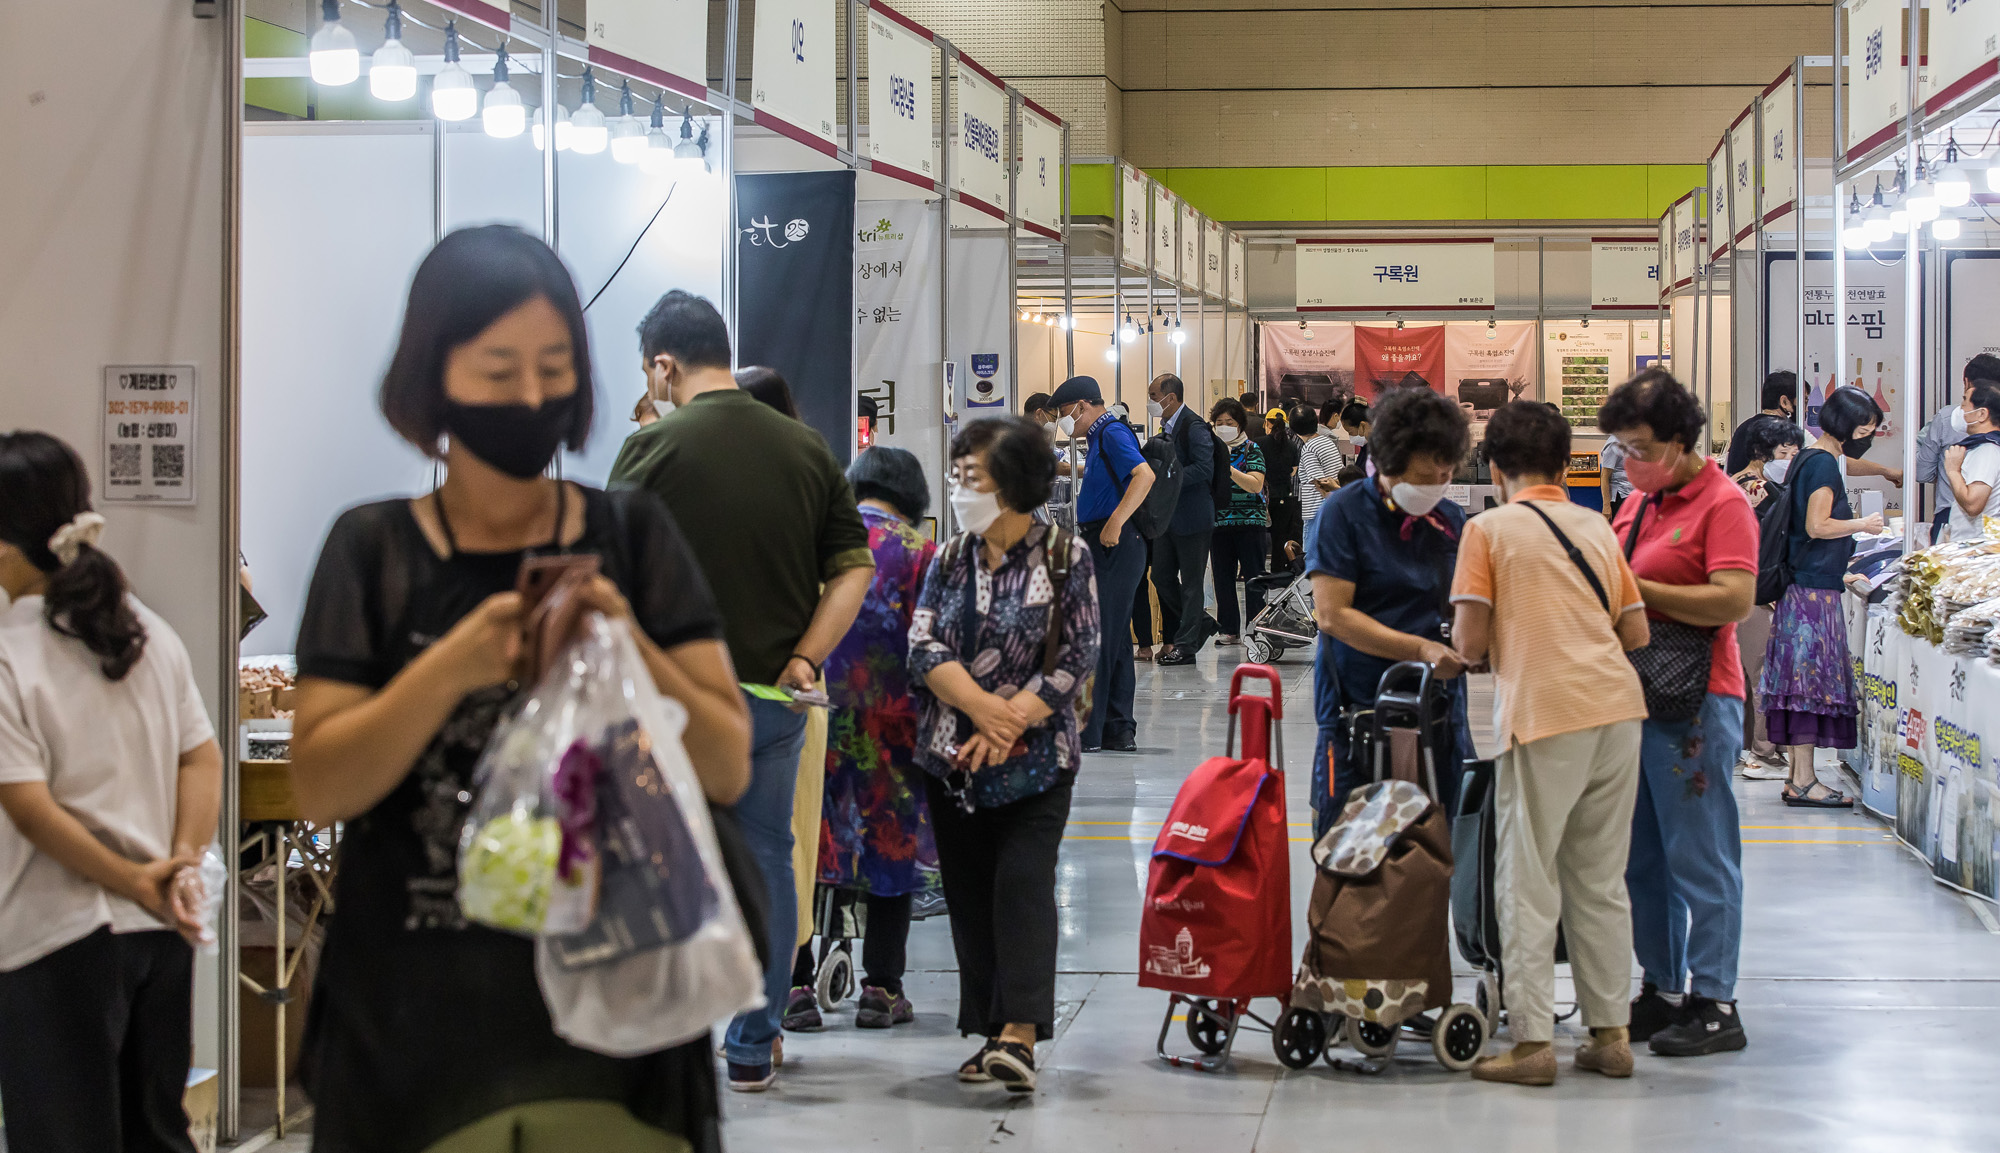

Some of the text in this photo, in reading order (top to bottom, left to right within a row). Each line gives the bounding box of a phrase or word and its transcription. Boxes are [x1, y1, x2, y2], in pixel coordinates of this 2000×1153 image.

[890, 73, 914, 120] 아리랑식품
[858, 260, 902, 280] 상에서
[1373, 264, 1418, 283] 구록원
[1847, 289, 1886, 301] 천연발효
[873, 306, 902, 324] 없는
[1391, 353, 1421, 362] 좋을까요?
